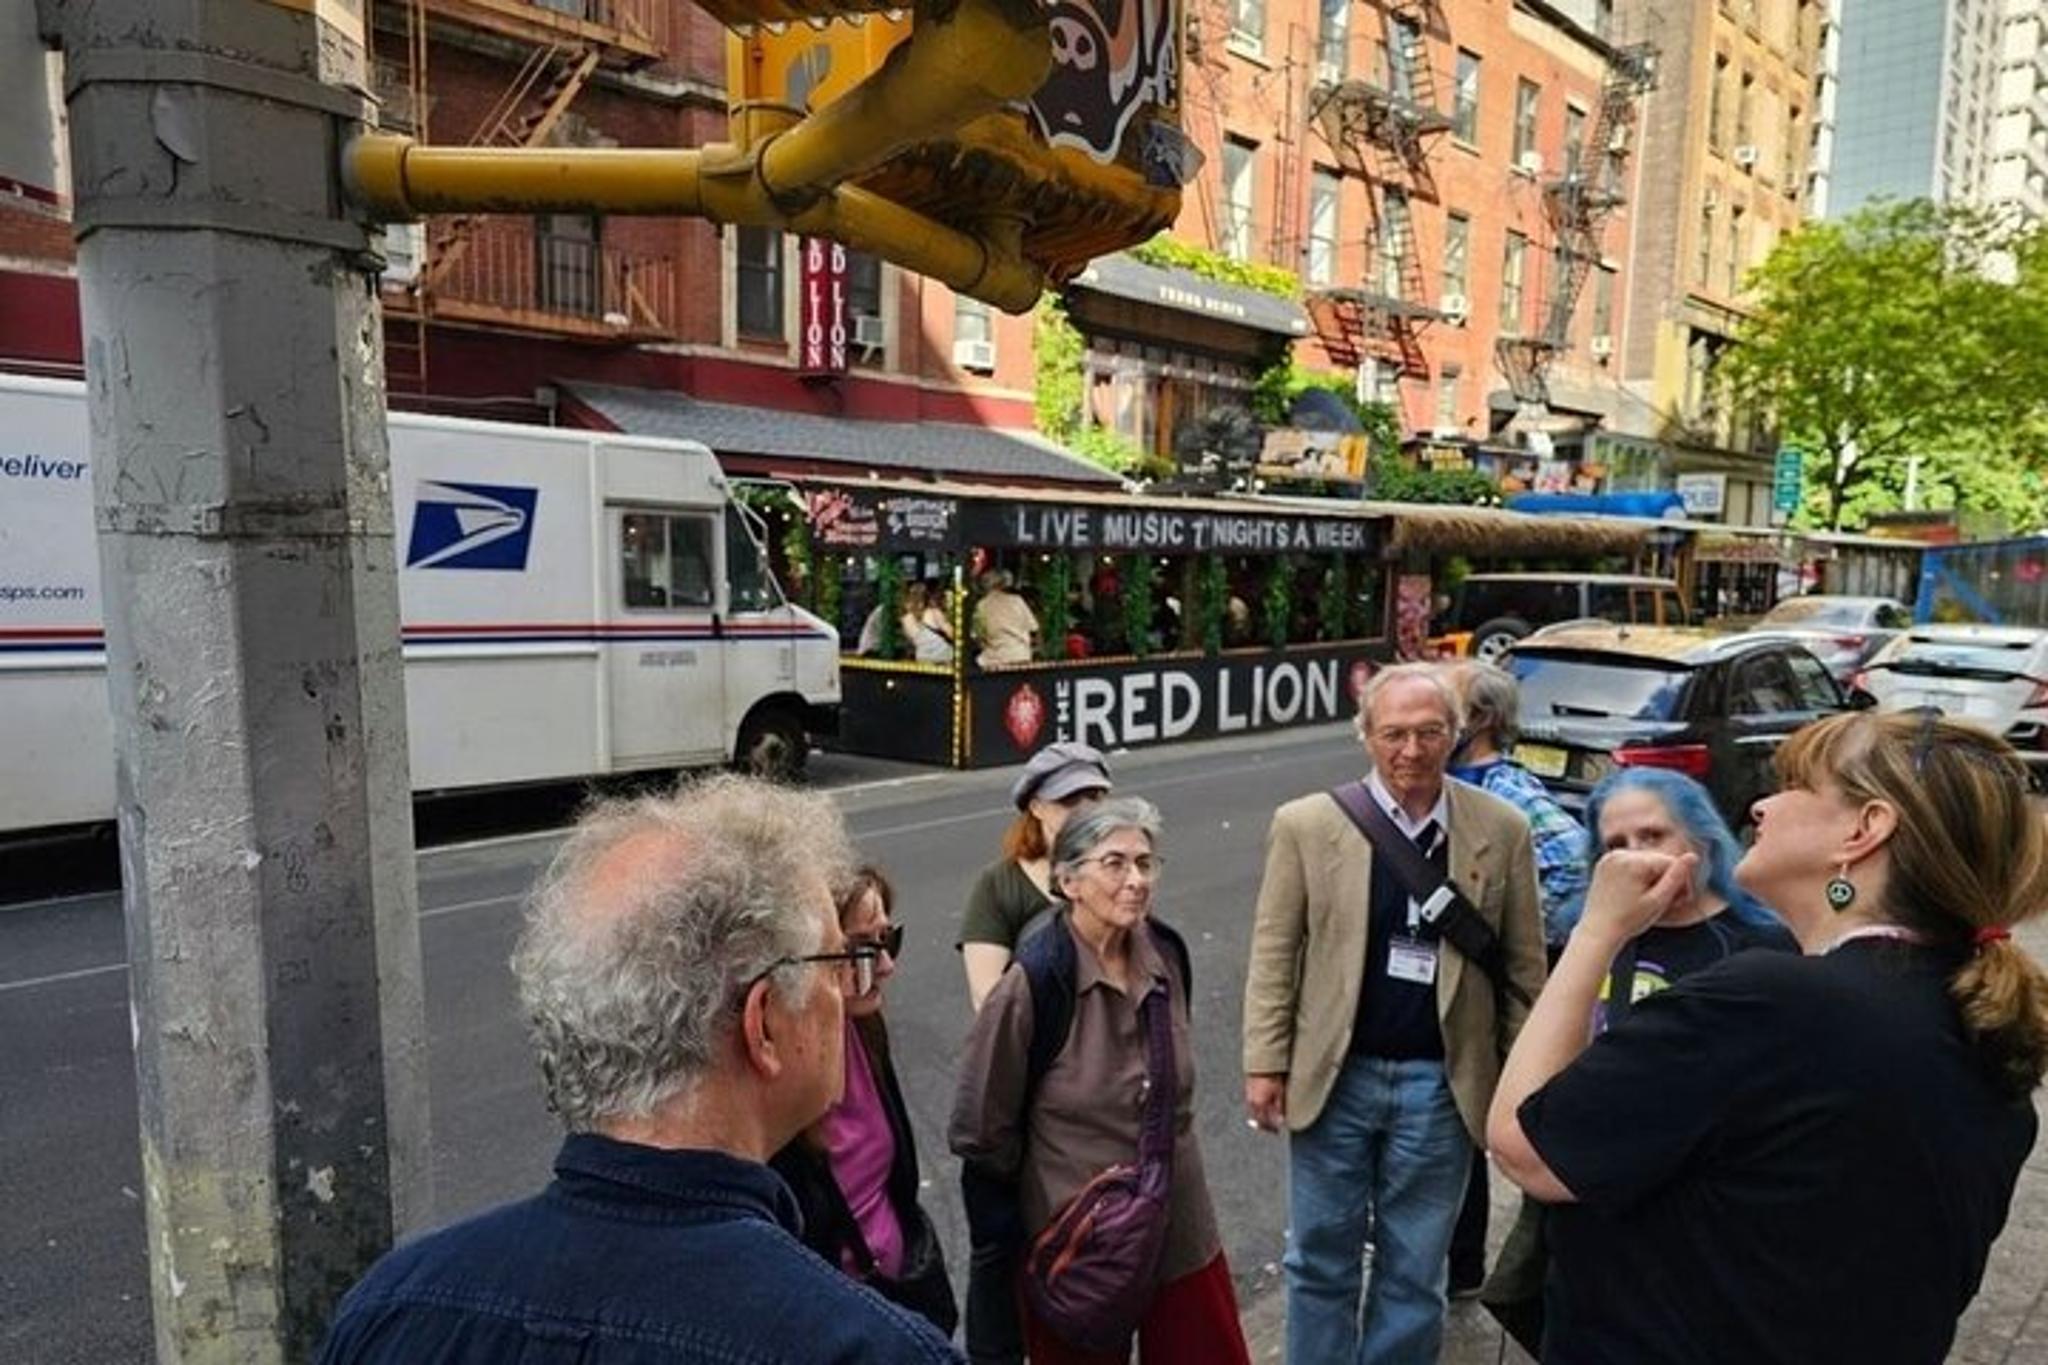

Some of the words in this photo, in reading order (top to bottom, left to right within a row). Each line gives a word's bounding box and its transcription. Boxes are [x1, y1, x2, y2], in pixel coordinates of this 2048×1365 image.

[807, 280, 823, 368] LION
[830, 280, 846, 369] LION
[0, 455, 88, 479] eliver
[1017, 504, 1091, 547] LIVE
[1103, 512, 1185, 547] MUSIC
[1212, 515, 1290, 549] NIGHTS
[1293, 518, 1311, 549] A
[1313, 521, 1366, 548] WEEK
[1056, 678, 1070, 744] THE
[1075, 670, 1201, 746] RED
[1218, 659, 1339, 732] LION
